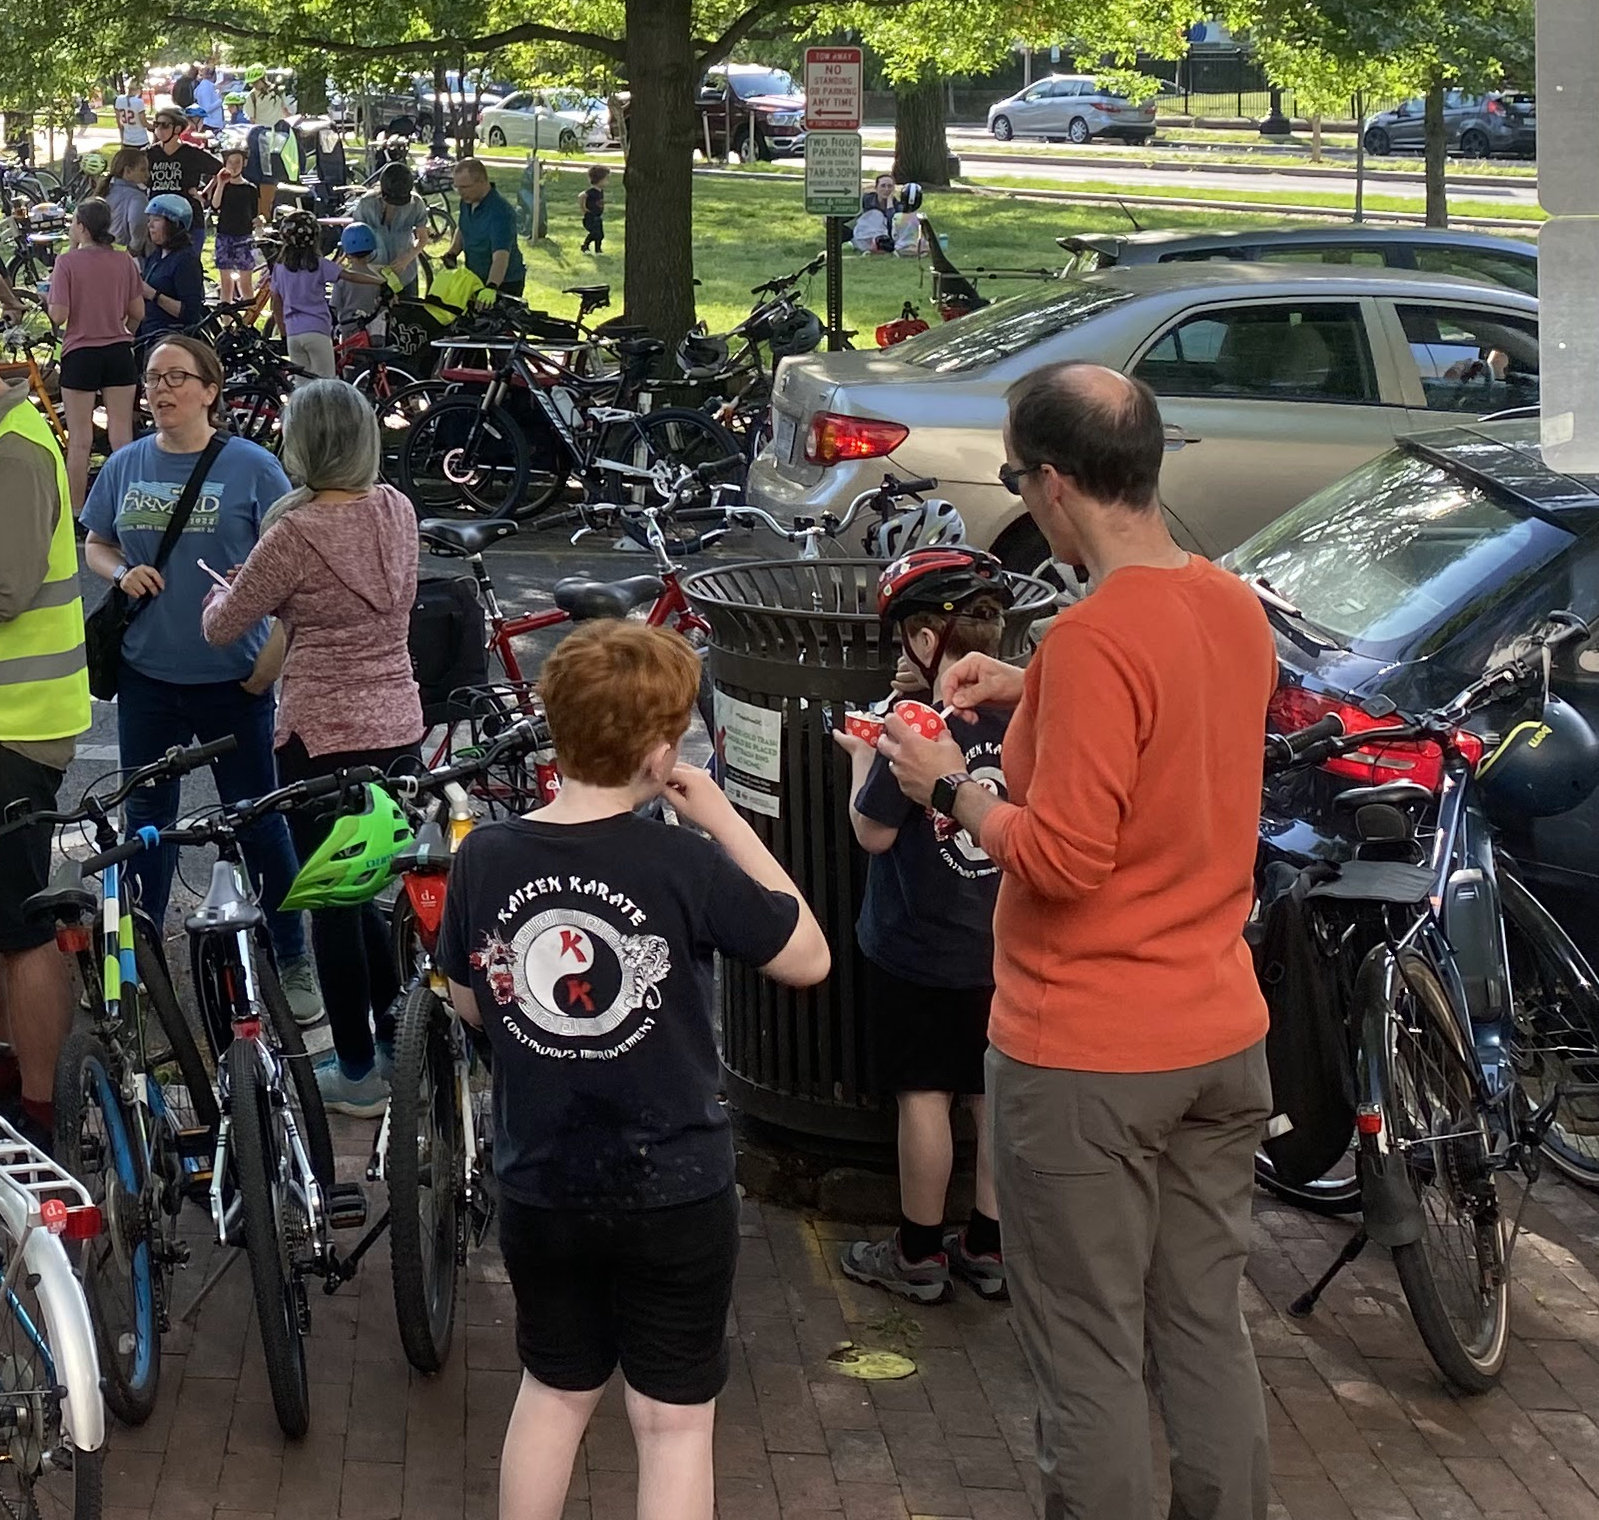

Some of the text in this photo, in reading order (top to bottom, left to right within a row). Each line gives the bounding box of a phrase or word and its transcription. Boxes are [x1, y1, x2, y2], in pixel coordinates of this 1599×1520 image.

[816, 52, 853, 60] TOW AWAY
[825, 64, 842, 75] NO
[813, 77, 853, 86] STANDING
[809, 87, 858, 96] OR PARKING
[812, 98, 854, 107] ANY TIME
[120, 109, 136, 125] 32
[808, 137, 859, 147] TWO HOUR
[812, 148, 855, 157] PARKING
[152, 161, 182, 170] MIND
[150, 170, 182, 181] YOUR
[497, 875, 647, 927] KAIZEN KARATE
[559, 930, 587, 963] K
[502, 1015, 657, 1061] CONTINUOUS IMPROVEMENT
